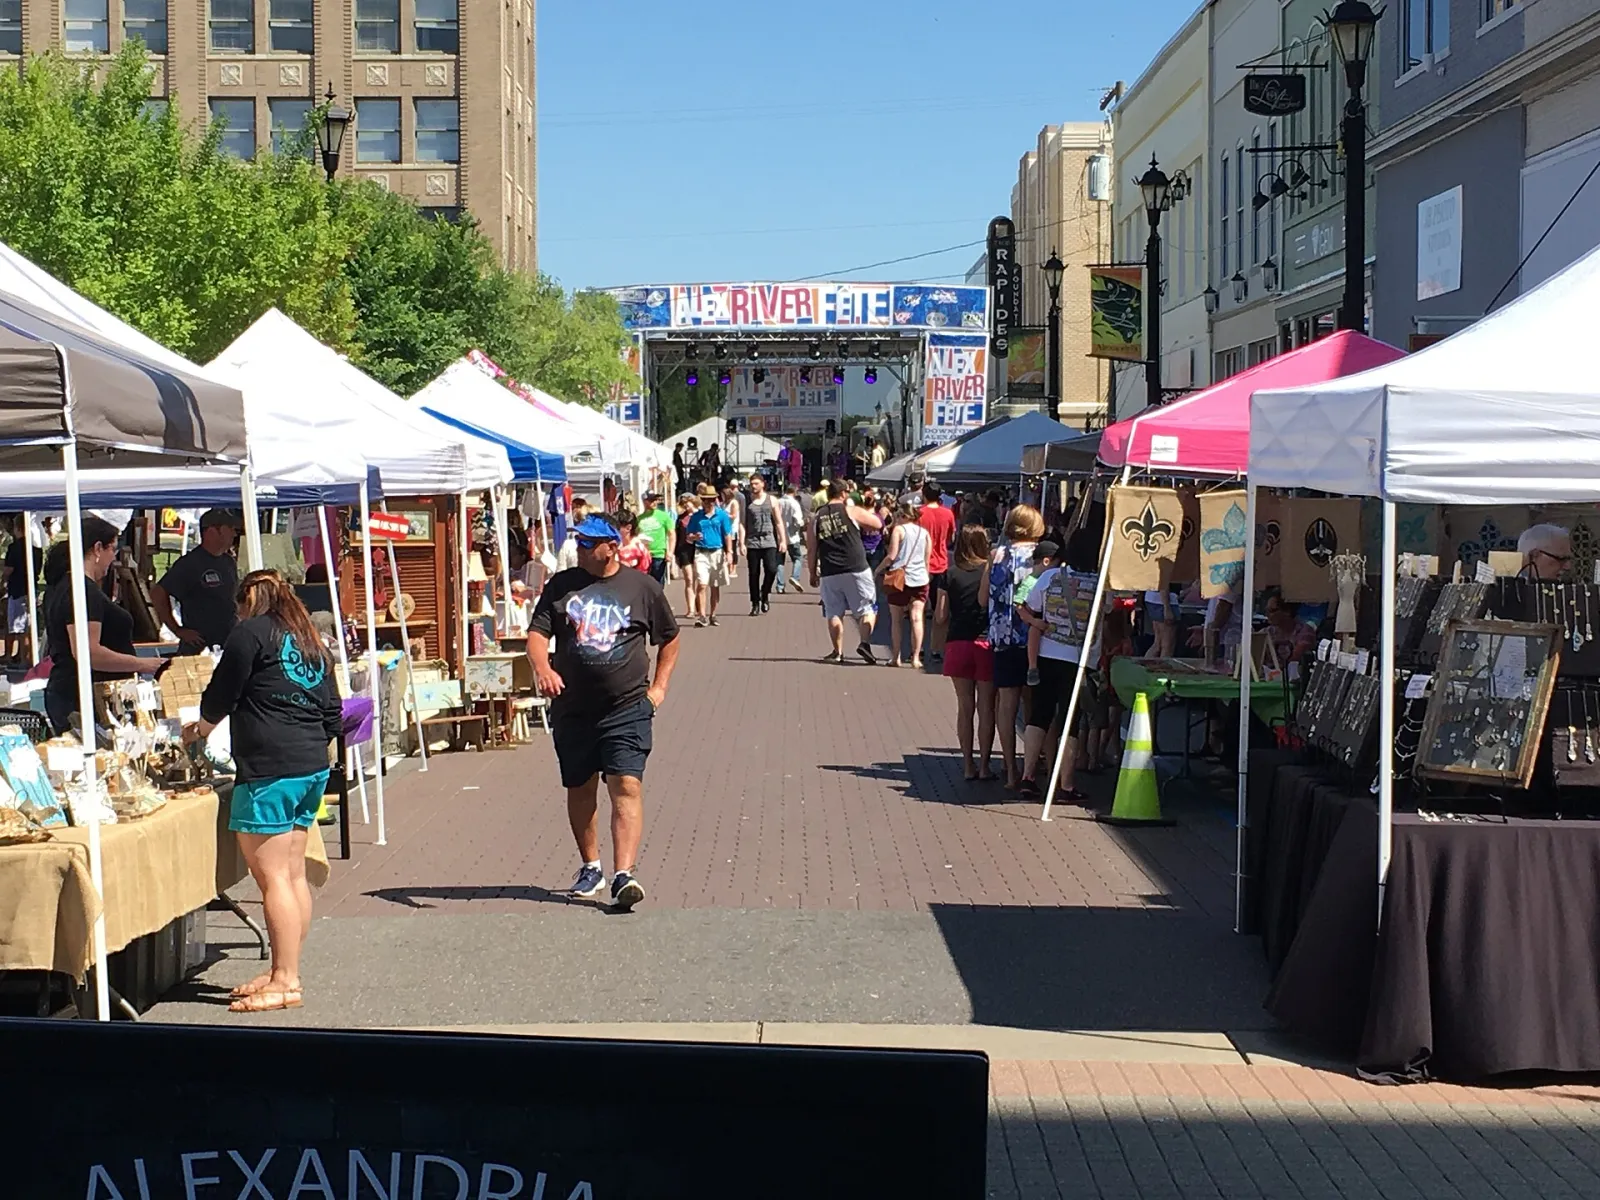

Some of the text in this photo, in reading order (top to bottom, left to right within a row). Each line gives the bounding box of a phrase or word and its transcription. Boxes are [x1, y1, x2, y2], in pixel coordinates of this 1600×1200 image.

[675, 286, 731, 326] ALEX
[732, 285, 812, 325] RIVER
[995, 248, 1009, 351] RAPIDES
[1012, 267, 1021, 328] FOUNDATI
[928, 348, 977, 377] ALEX
[934, 374, 985, 401] RIVER
